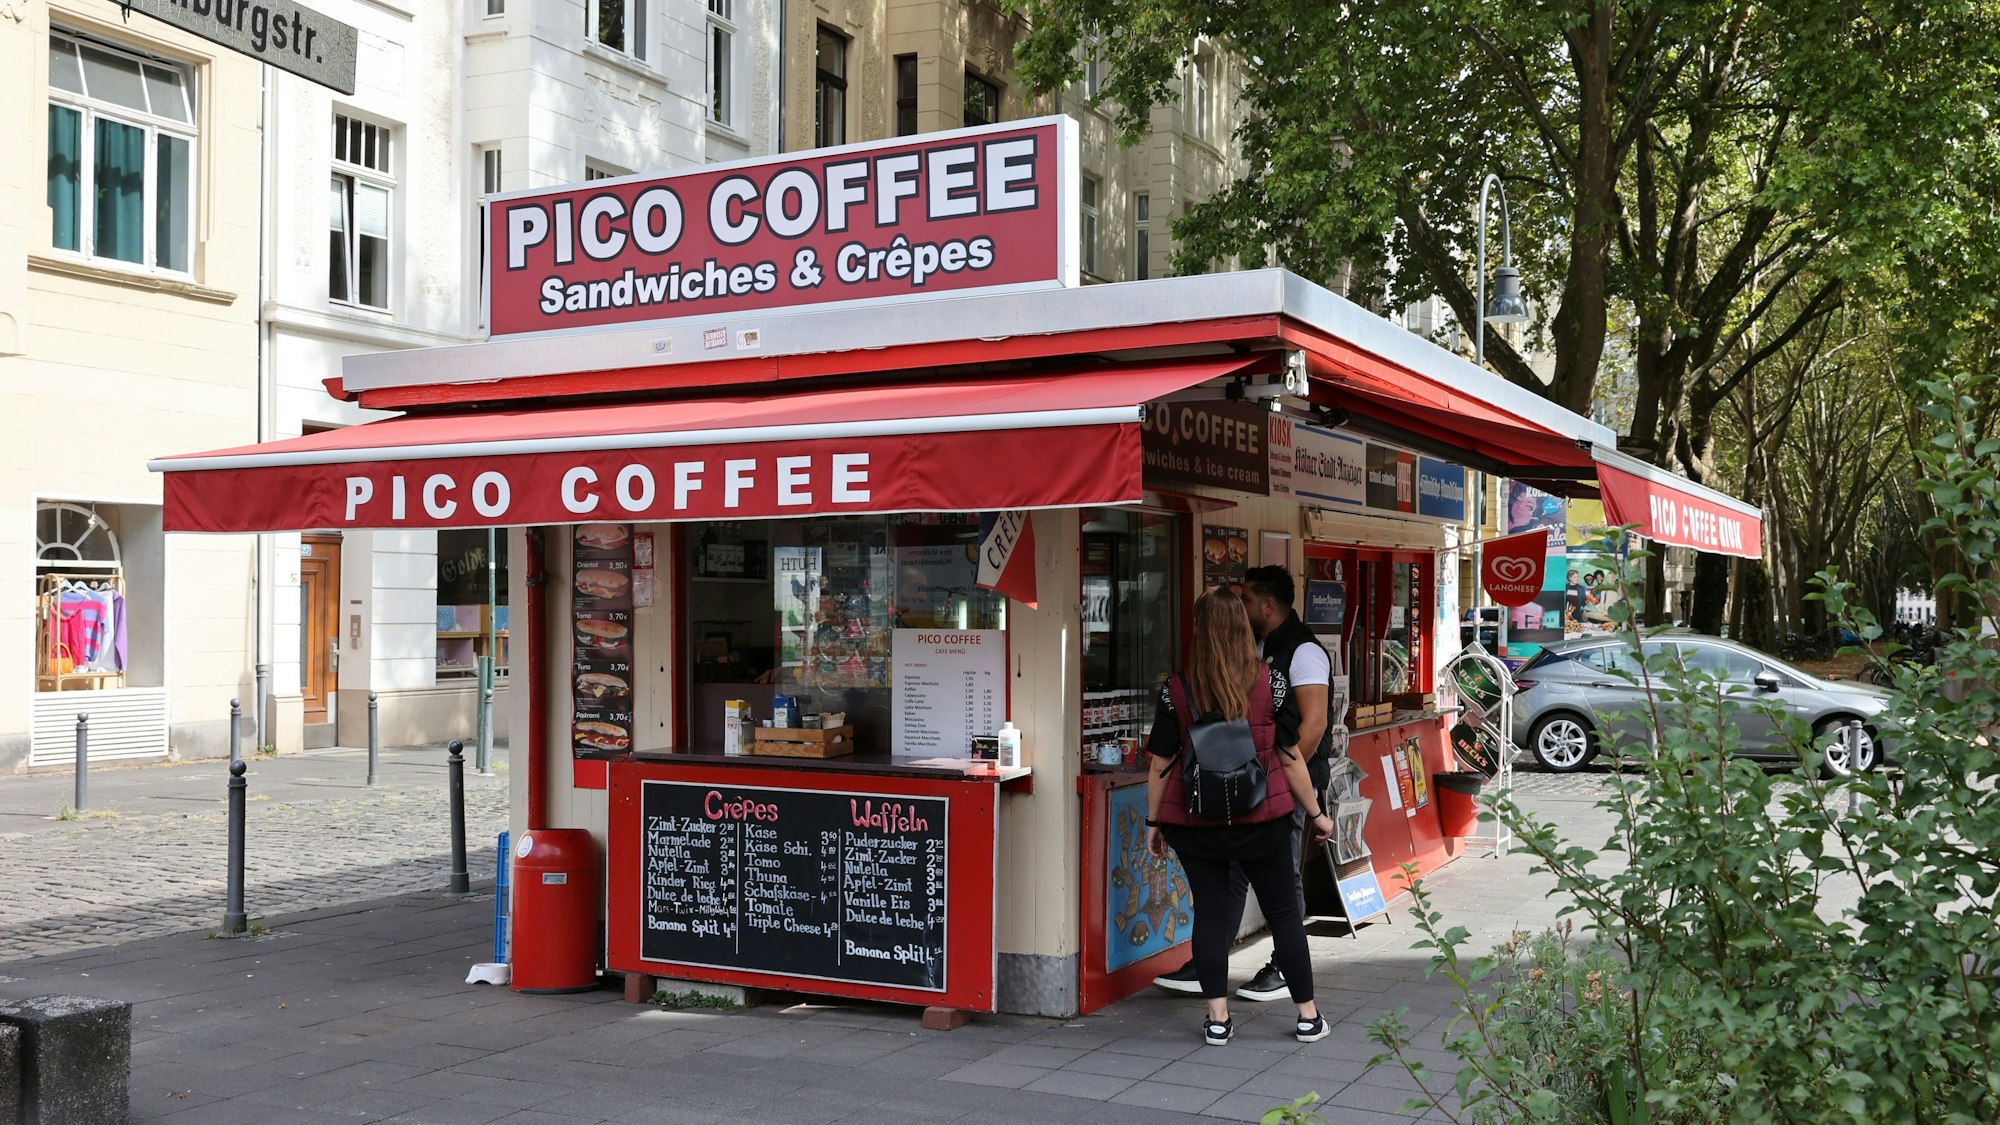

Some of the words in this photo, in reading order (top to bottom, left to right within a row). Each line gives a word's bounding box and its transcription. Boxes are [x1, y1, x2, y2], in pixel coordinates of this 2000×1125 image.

[170, 0, 323, 63] burgstr.
[506, 184, 685, 270] PICO
[707, 134, 1039, 246] COFFEE
[540, 258, 778, 316] Sandwiches
[789, 248, 822, 289] &
[835, 233, 996, 286] Crêpes
[1141, 403, 1171, 435] CO
[1180, 407, 1259, 455] COFFEE
[1269, 416, 1292, 448] KIOSK
[1141, 447, 1190, 472] wiches
[1194, 455, 1203, 474] &
[1206, 459, 1224, 477] ice
[1227, 465, 1260, 485] cream
[344, 471, 511, 520] PICO
[560, 452, 871, 514] COFFEE
[1649, 494, 1677, 538] PICO
[1681, 504, 1718, 546] COFFEE
[1489, 583, 1535, 594] LANGNESE
[917, 634, 942, 645] PICO
[944, 634, 982, 645] COFFEE
[576, 663, 592, 671] Tuna
[576, 711, 600, 719] Pastrami
[704, 790, 779, 822] Crêpes
[850, 798, 929, 834] Waffeln
[648, 816, 717, 834] Zimt-Zucker
[744, 823, 778, 839] Käse
[647, 831, 712, 848] Marmelade
[744, 839, 778, 853] Käse
[783, 840, 813, 857] Schi.
[845, 831, 918, 851] Puderzucker
[647, 844, 692, 859] Nutella
[744, 852, 781, 868] Tomo
[844, 846, 918, 865] Zimt-Zucker
[647, 857, 710, 875] Apfel-Zimt
[744, 867, 788, 884] Thuna
[844, 861, 889, 877] Nutella
[647, 871, 687, 888] Kinder
[843, 874, 913, 893] Apfel-Zimt
[647, 886, 677, 902] Dulce
[680, 888, 694, 903] de
[696, 890, 721, 906] leche
[843, 890, 887, 908] Vanille
[890, 894, 911, 910] Eis
[744, 897, 794, 917] Tomate
[647, 914, 688, 932] Banana
[691, 919, 721, 938] Split
[744, 912, 781, 934] Triple
[783, 917, 822, 935] Cheese
[845, 907, 878, 924] Dulce
[879, 910, 893, 926] de
[895, 911, 925, 931] leche
[844, 939, 891, 960] Banana
[893, 943, 926, 965] Split
